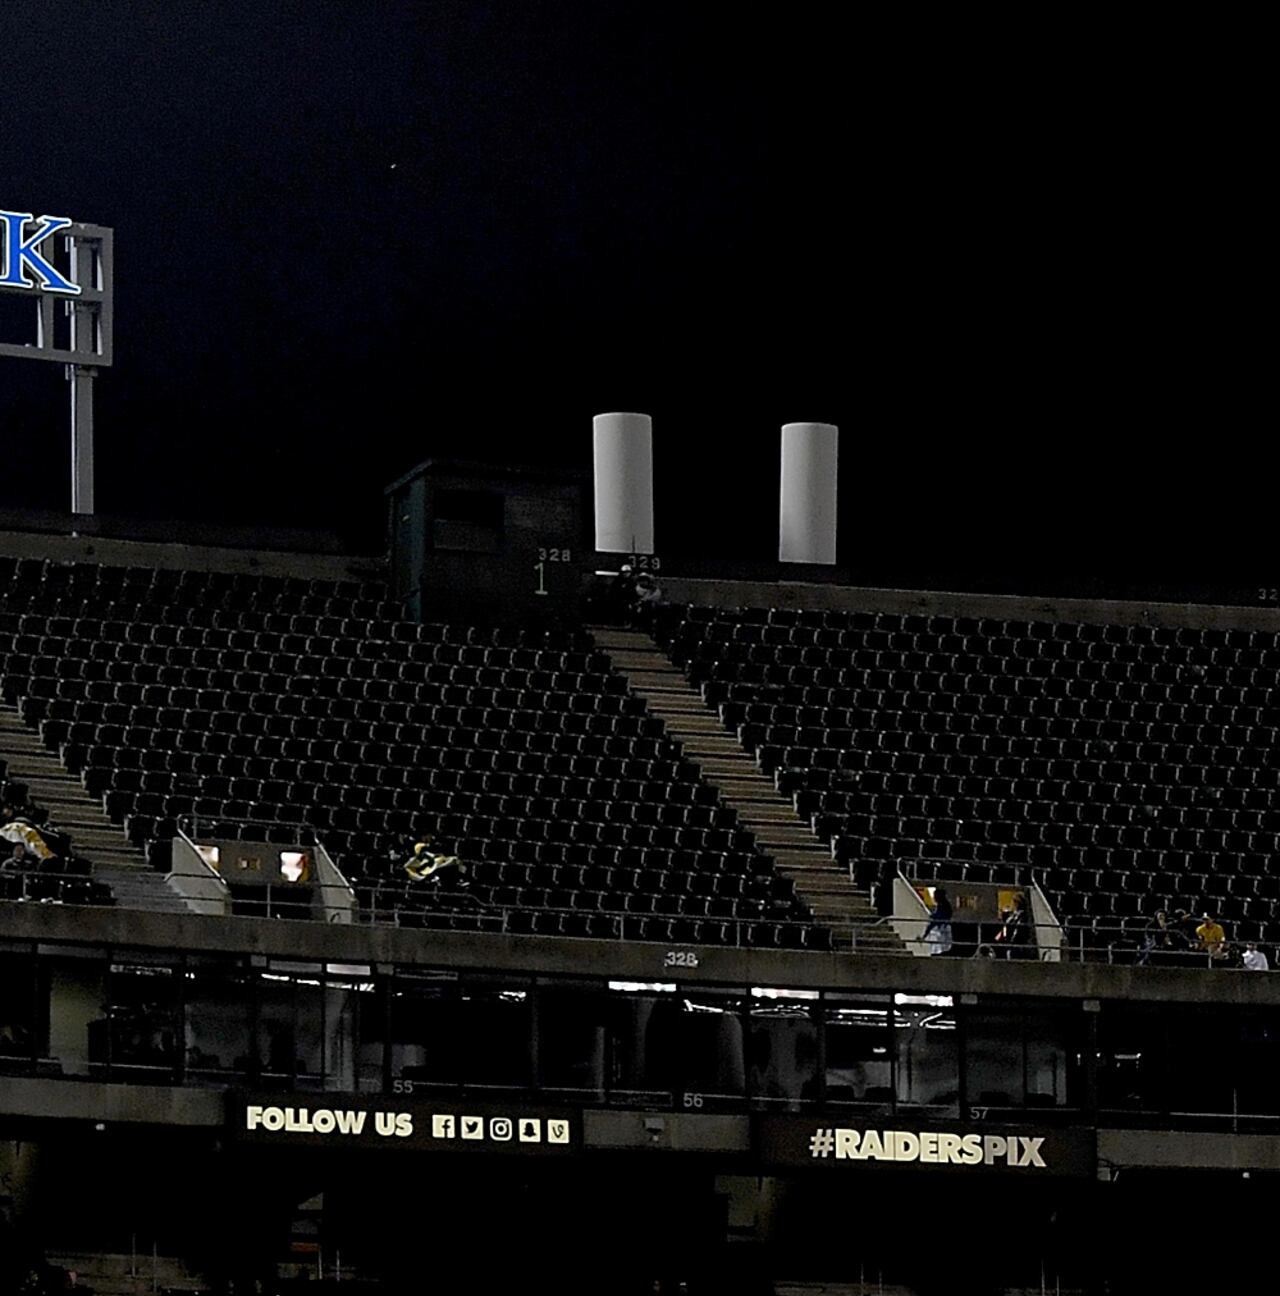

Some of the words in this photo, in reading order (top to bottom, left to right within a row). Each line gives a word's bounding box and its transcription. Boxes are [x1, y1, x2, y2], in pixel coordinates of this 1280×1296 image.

[684, 1094, 703, 1107] 56
[248, 1107, 364, 1135] FOLLOW
[375, 1112, 412, 1137] US
[809, 1128, 1045, 1167] #RAIDERSPIX
